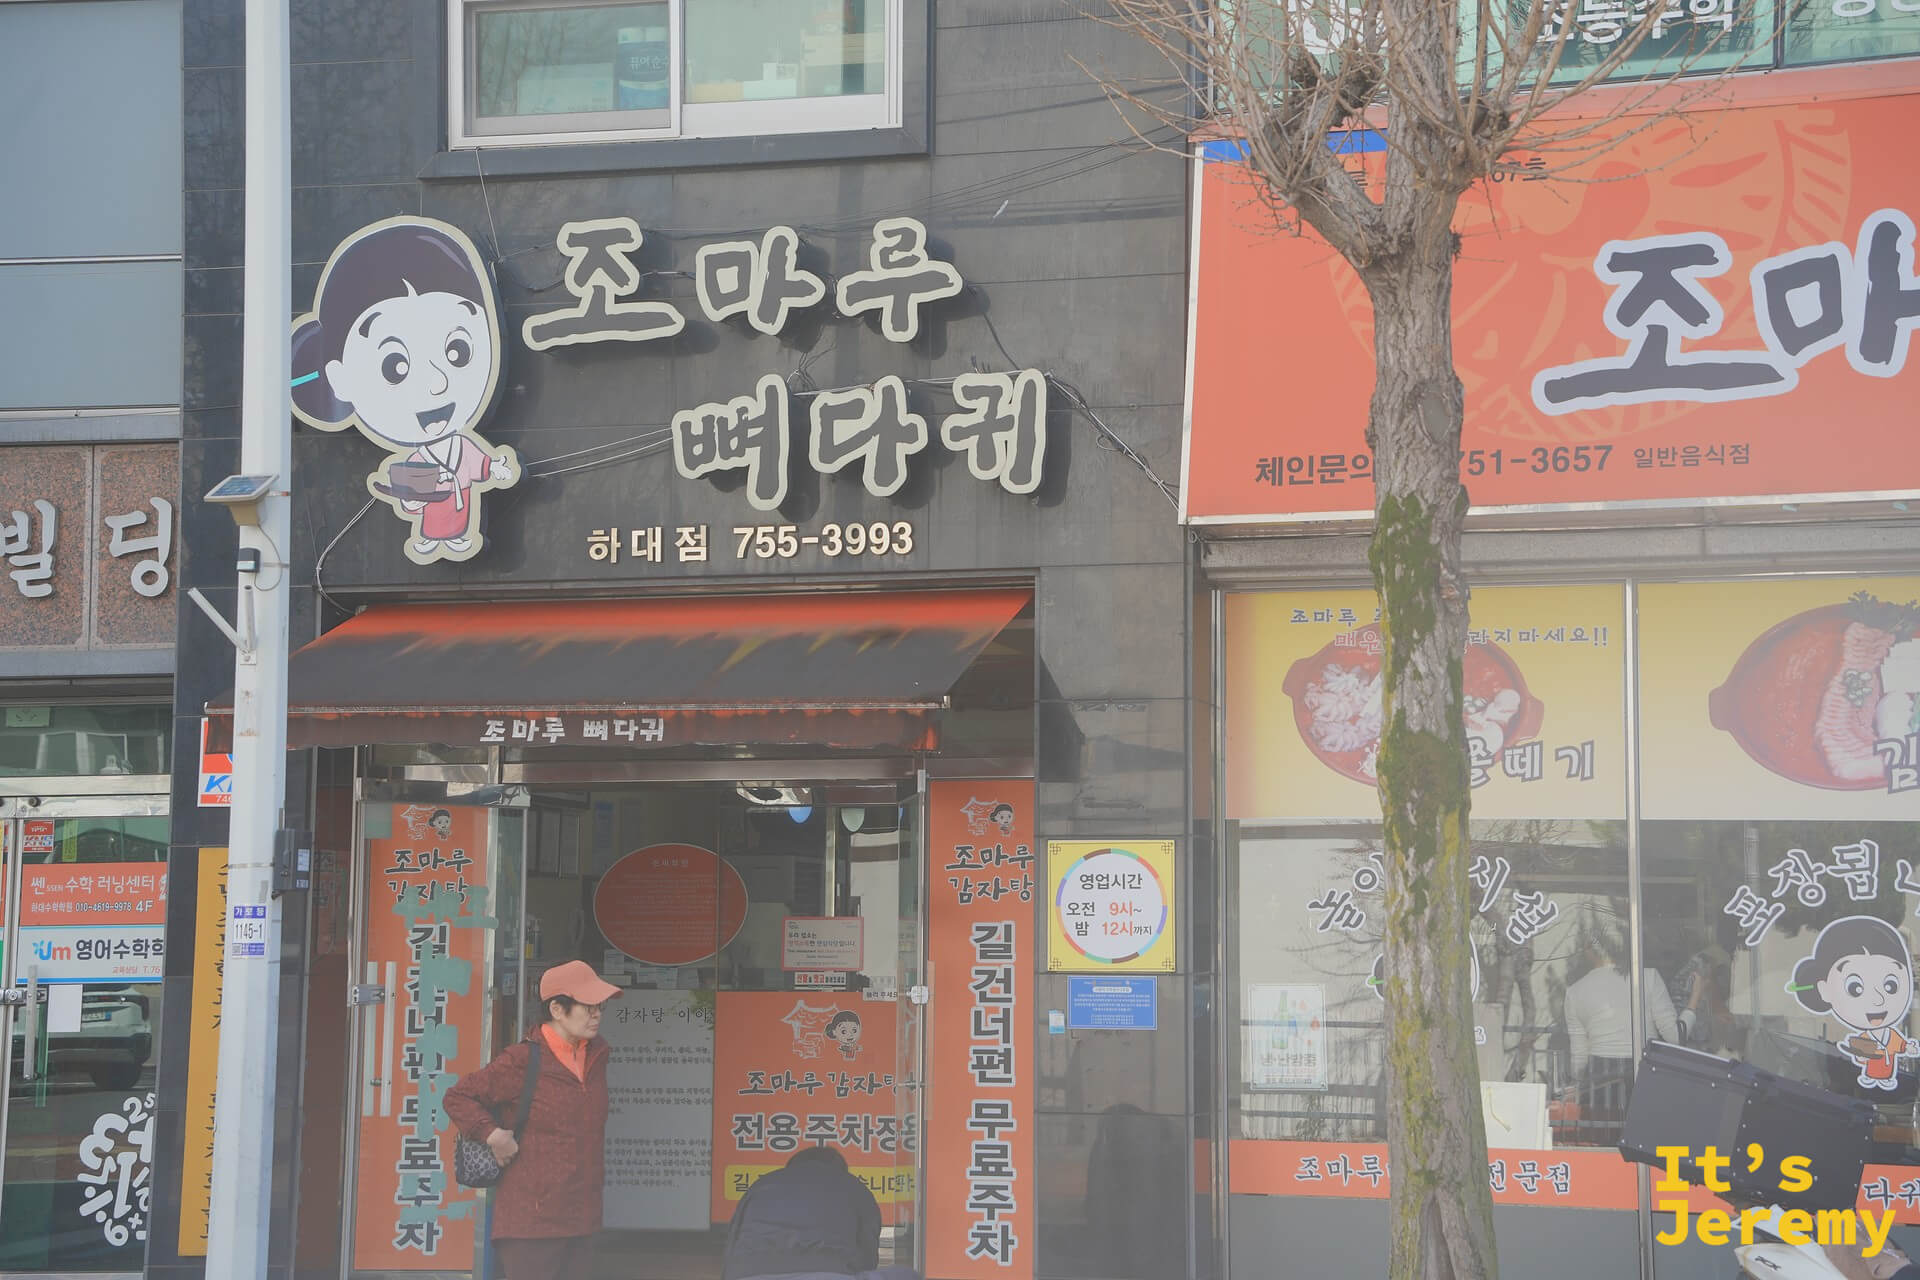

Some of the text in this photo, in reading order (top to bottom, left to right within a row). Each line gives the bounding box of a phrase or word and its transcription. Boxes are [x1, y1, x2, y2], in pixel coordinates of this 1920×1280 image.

[523, 217, 963, 351] 조마루
[671, 368, 1046, 511] 뼈다귀
[1633, 443, 1751, 470] 일반음식점
[587, 521, 914, 564] 하대점 755-3993
[1290, 608, 1357, 627] 조마루
[480, 716, 664, 744] 조마루 뼈다귀
[384, 847, 474, 874] 조마루
[944, 844, 1035, 871] 조마루
[65, 876, 94, 894] 수학
[97, 874, 156, 895] 러닝센터
[948, 875, 1034, 905] 감자탕
[1079, 873, 1143, 891] 영업시간
[135, 899, 154, 913] 4F
[1066, 901, 1096, 917] 오전
[235, 922, 263, 940] 1145-1
[1074, 921, 1152, 937] 밤 12시까지
[616, 1007, 665, 1024] 감자탕
[968, 921, 1016, 1088] 길건너편
[737, 1070, 824, 1097] 조마루
[965, 1099, 1018, 1266] 무료주차
[1295, 1154, 1385, 1187] 조마루
